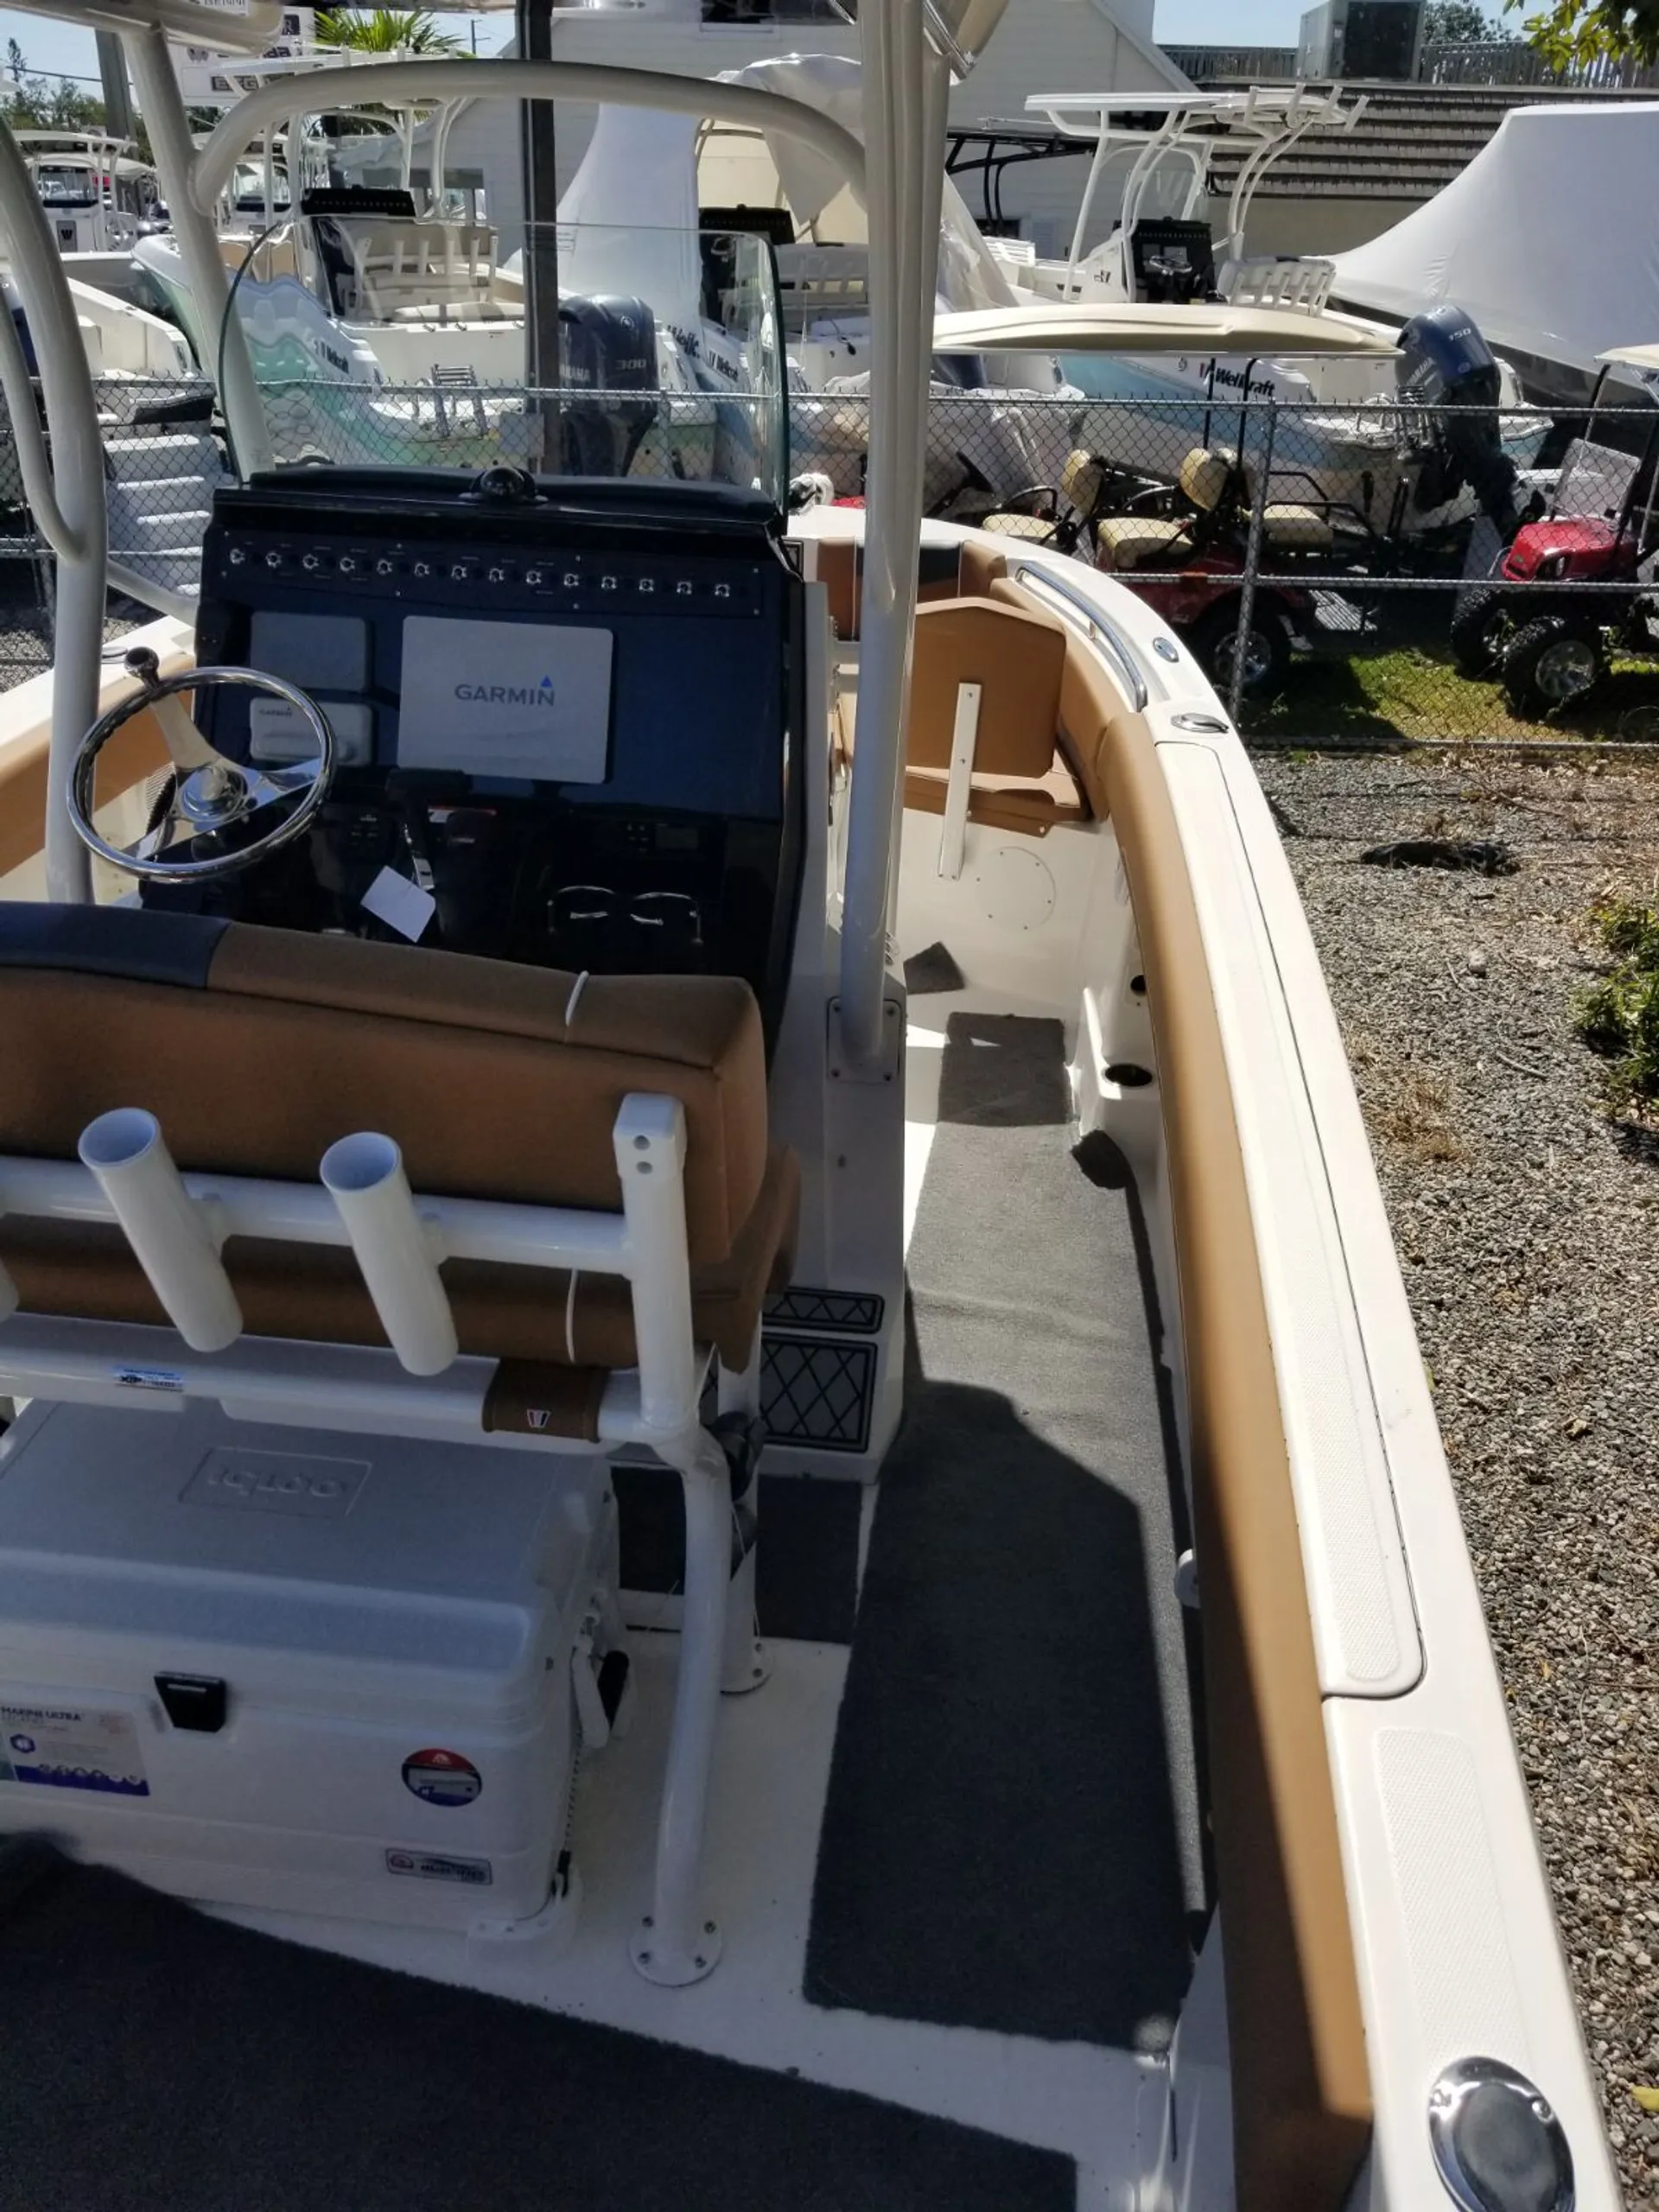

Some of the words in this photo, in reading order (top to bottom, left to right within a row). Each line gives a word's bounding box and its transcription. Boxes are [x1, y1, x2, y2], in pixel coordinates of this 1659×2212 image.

[1448, 328, 1471, 340] 150
[615, 358, 647, 371] 300
[1215, 366, 1275, 397] Wellraft
[454, 683, 555, 706] GARMIN
